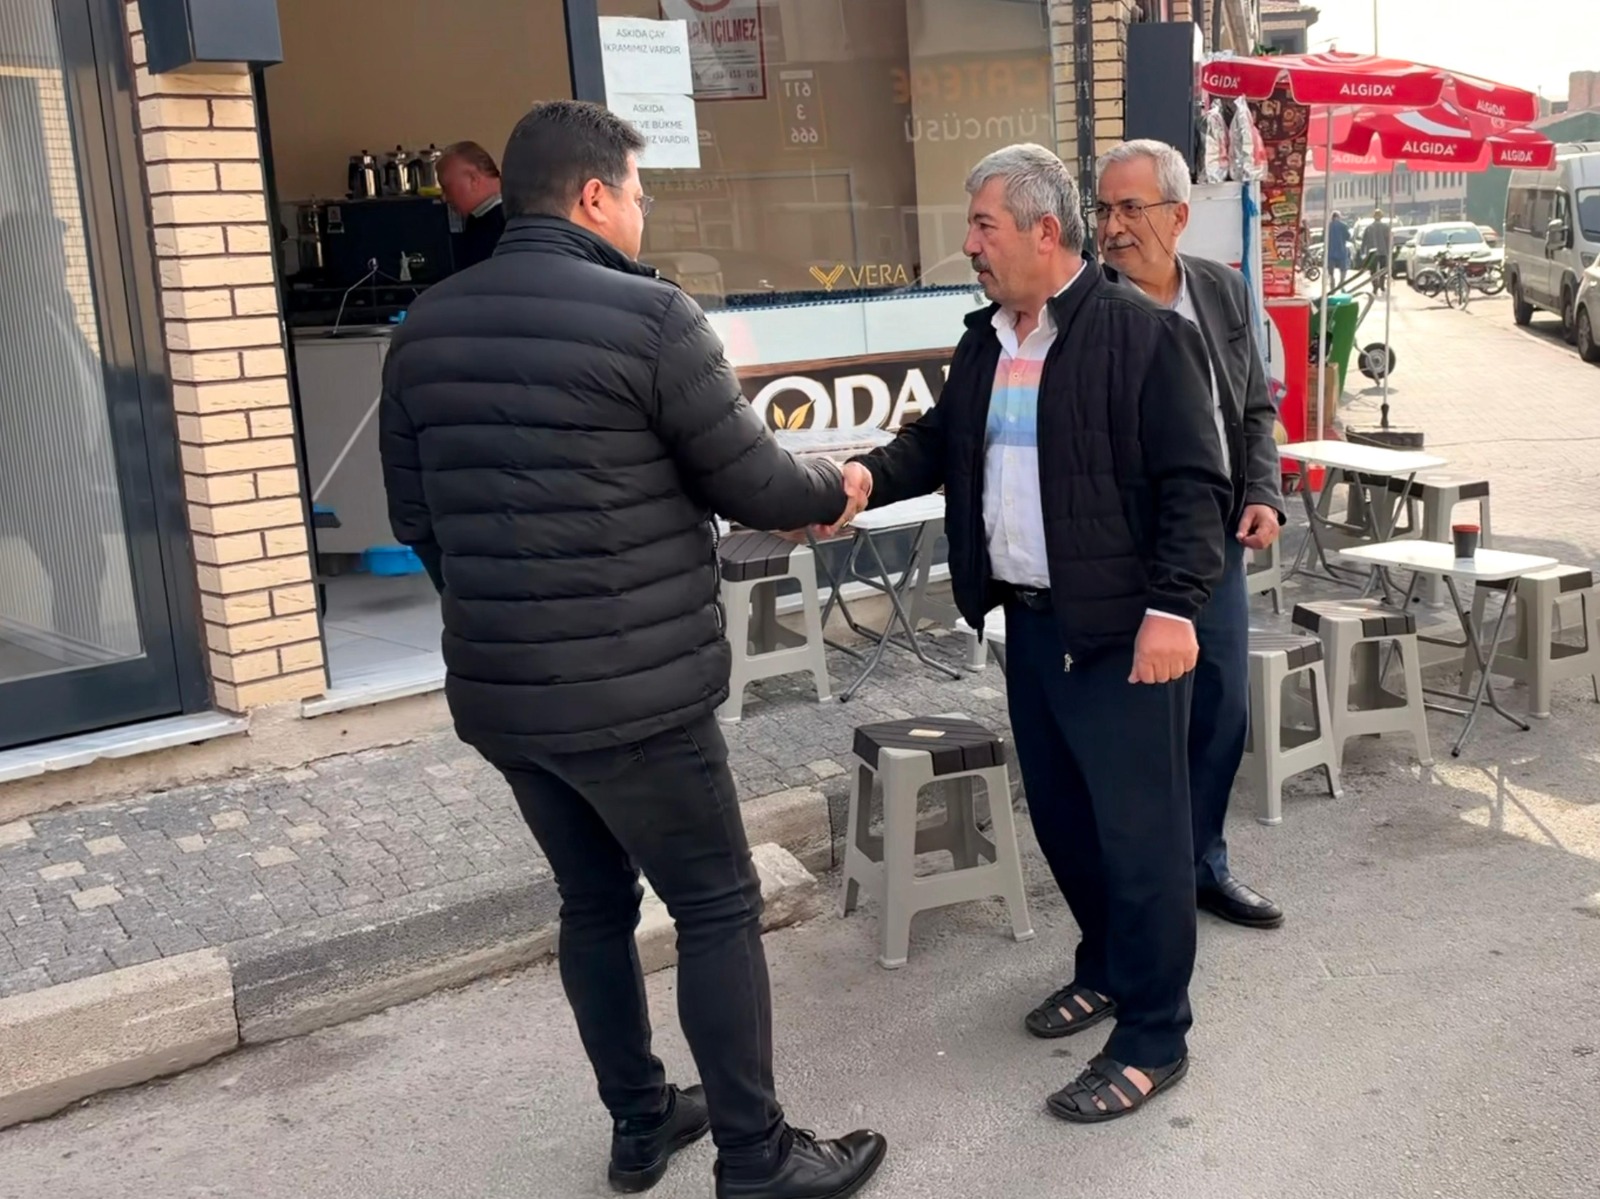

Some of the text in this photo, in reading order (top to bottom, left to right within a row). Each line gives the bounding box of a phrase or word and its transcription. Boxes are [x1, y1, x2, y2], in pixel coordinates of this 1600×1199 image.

[616, 28, 665, 40] ASKIDA ÇAY
[710, 16, 757, 47] İÇİLMEZ
[649, 45, 681, 55] VARDIR
[633, 104, 664, 113] ASKIDA
[652, 119, 683, 129] BÜKME
[658, 135, 690, 145] VARDIR
[848, 264, 909, 286] VERA
[751, 364, 951, 432] ODA
